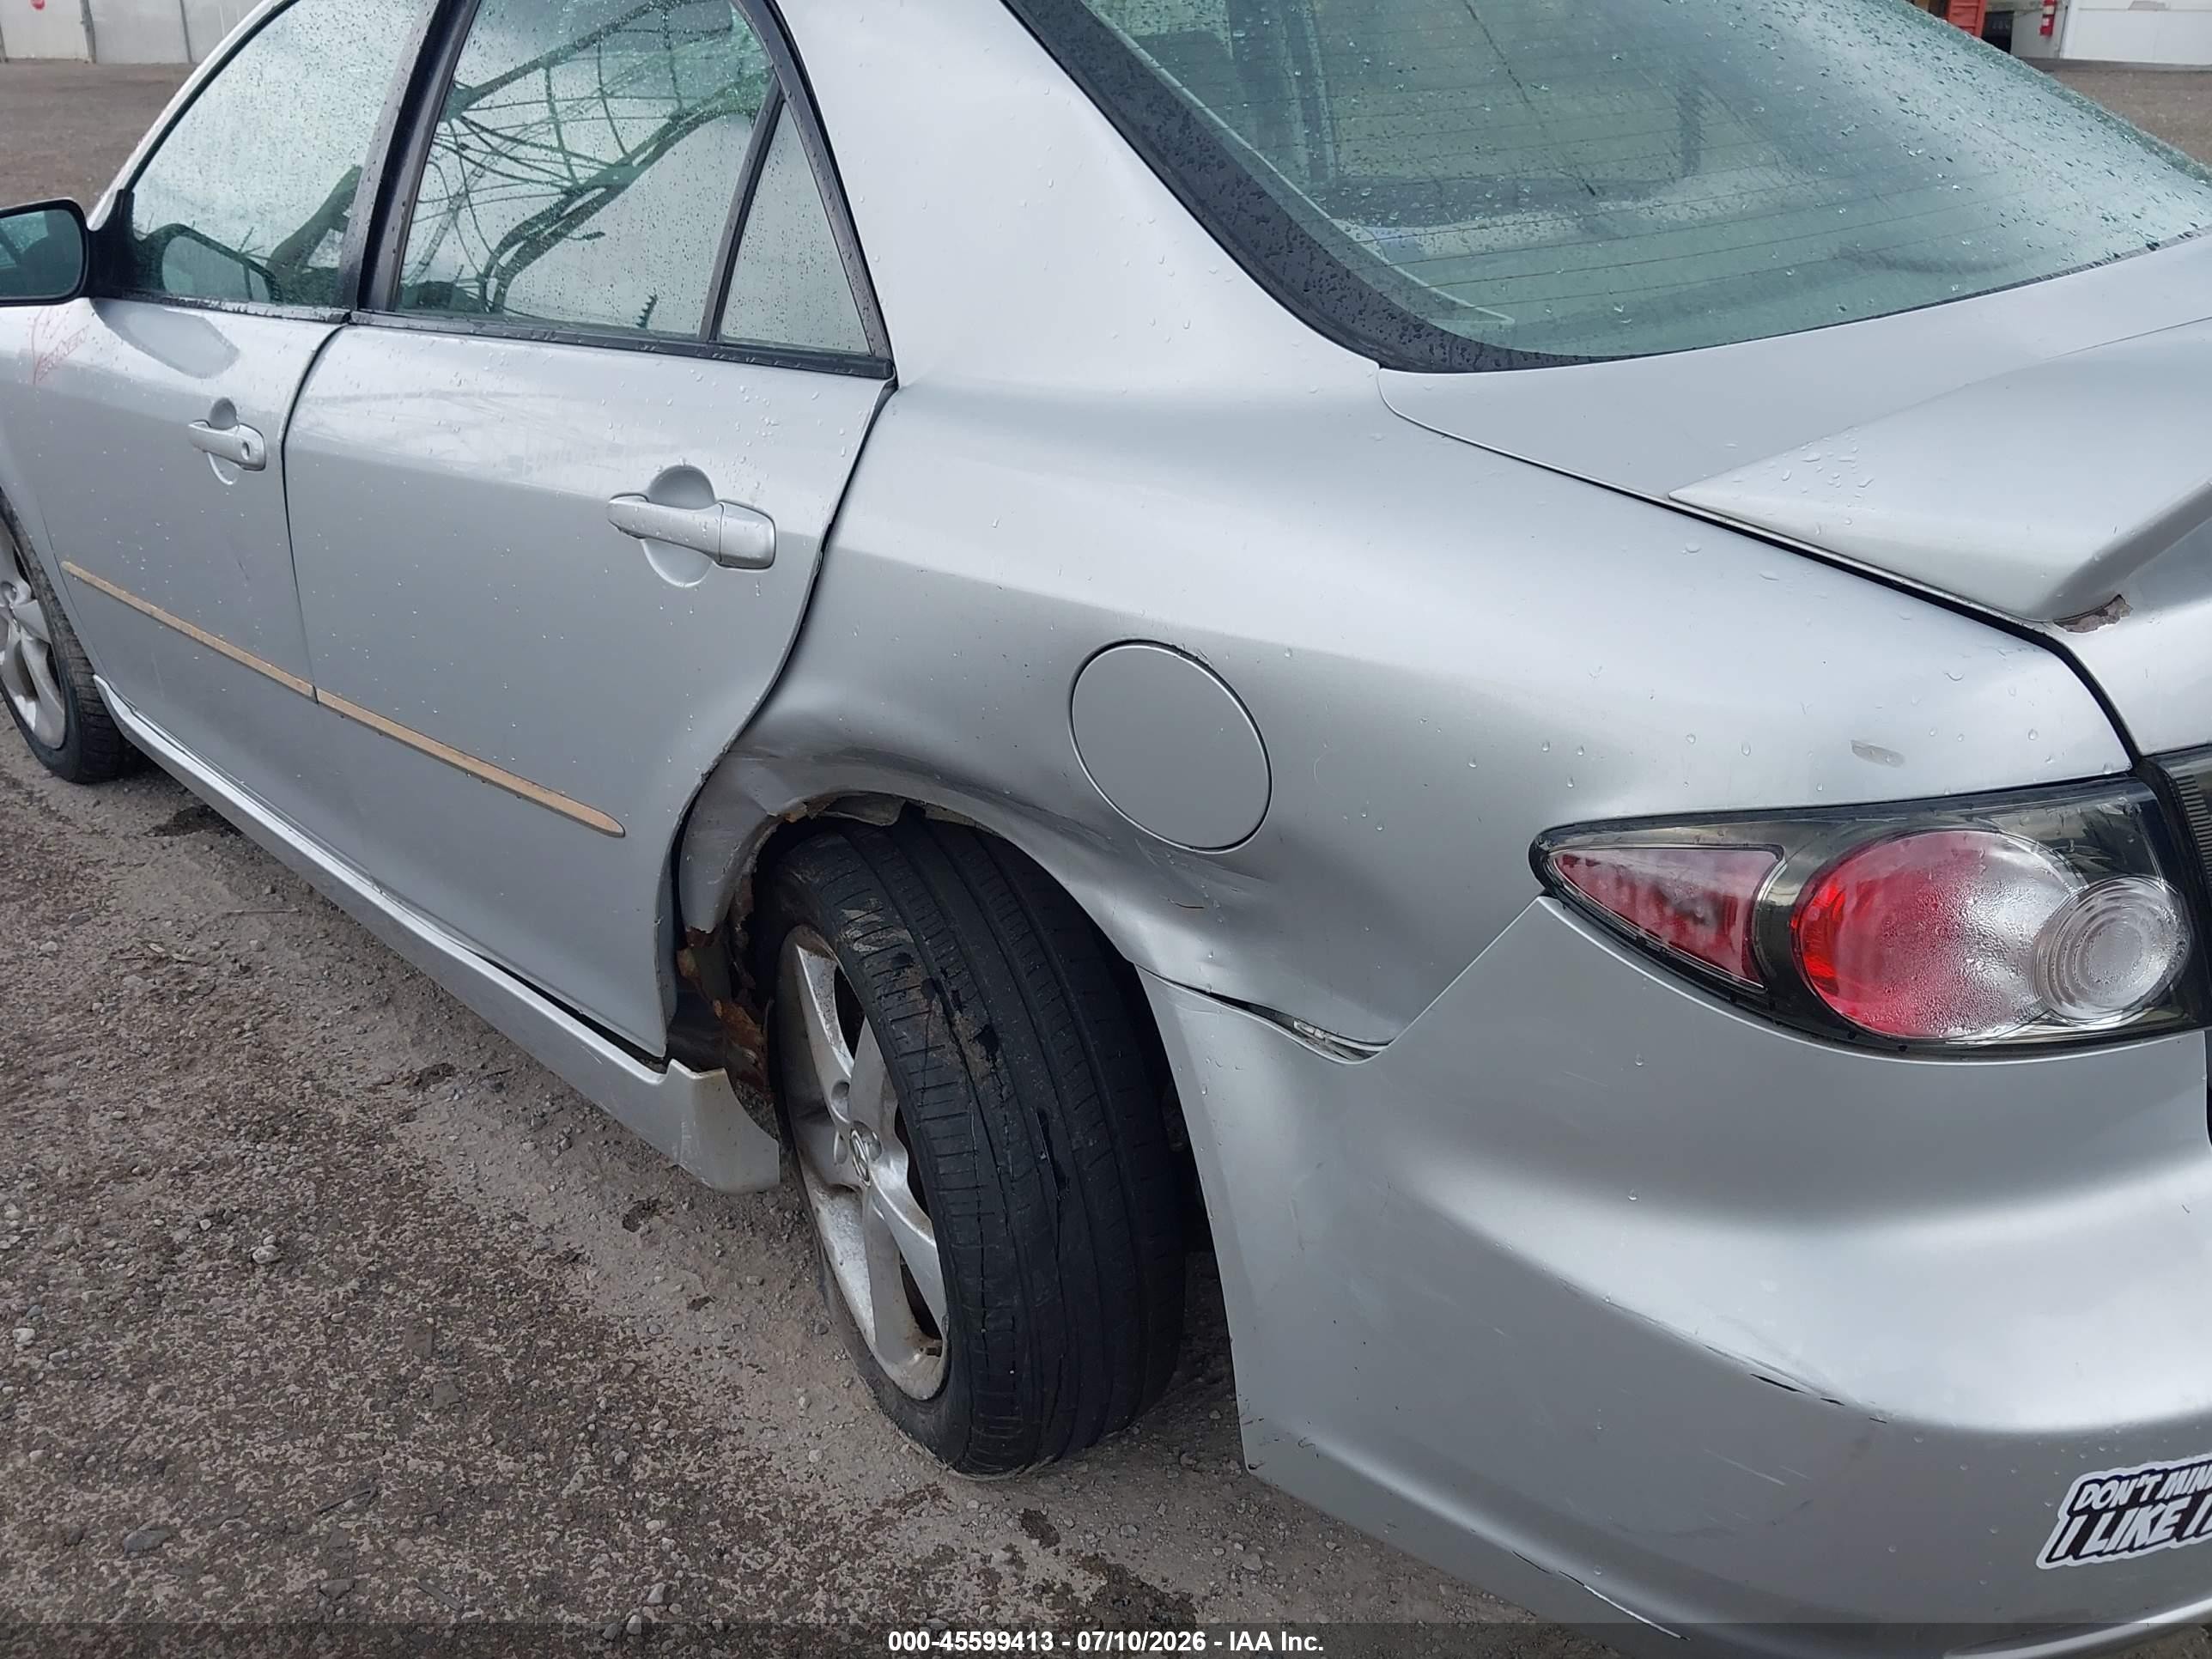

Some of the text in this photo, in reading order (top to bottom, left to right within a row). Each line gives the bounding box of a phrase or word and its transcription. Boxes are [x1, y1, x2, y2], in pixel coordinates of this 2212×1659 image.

[2073, 1474, 2163, 1511] DON'T
[2051, 1514, 2088, 1559] I
[2078, 1495, 2192, 1557] LIKE
